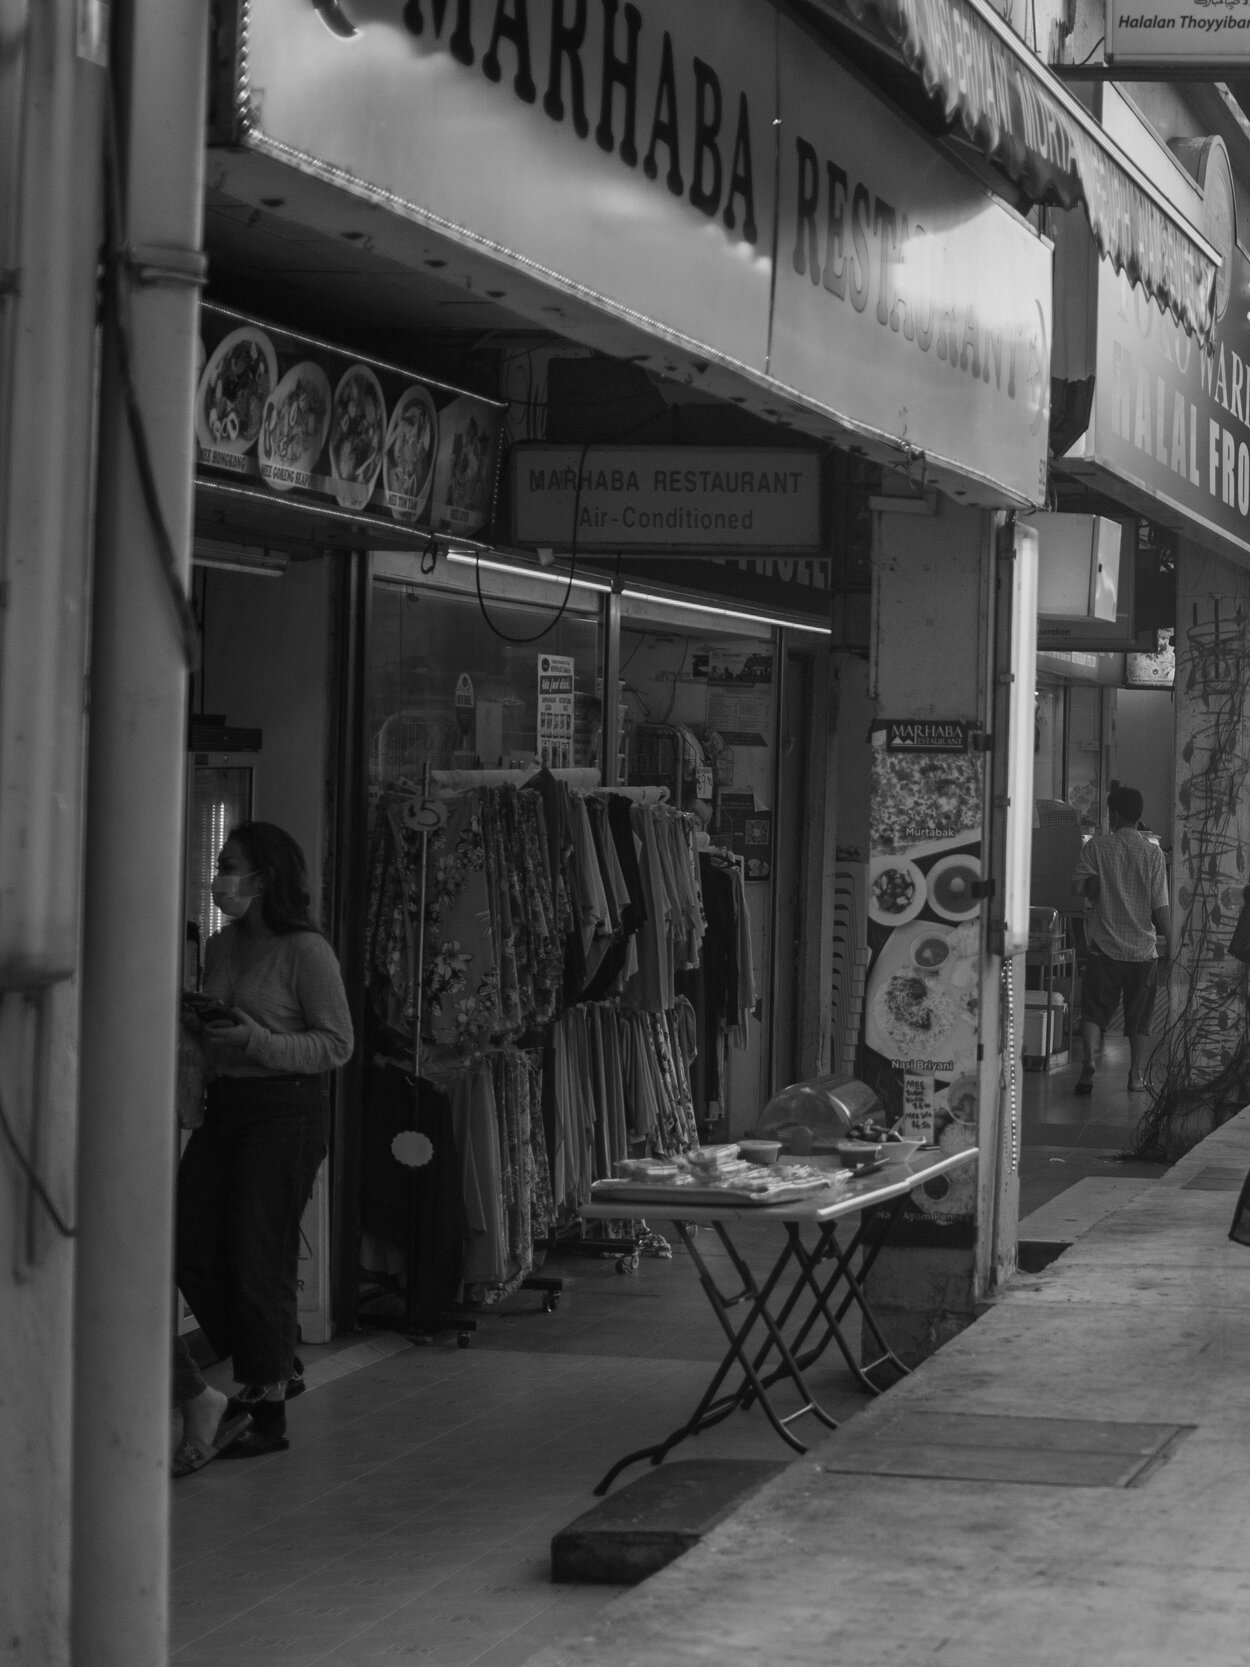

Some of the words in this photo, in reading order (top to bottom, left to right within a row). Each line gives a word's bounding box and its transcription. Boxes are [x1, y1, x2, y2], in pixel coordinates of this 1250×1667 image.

[1118, 15, 1175, 28] Halalan
[529, 469, 641, 493] MARHABA
[653, 469, 802, 493] RESTAURANT
[578, 505, 753, 530] Air-Conditioned
[891, 724, 963, 745] MARHABA
[905, 828, 955, 837] Murtabak
[891, 1060, 914, 1070] Nasi
[916, 1060, 953, 1072] Briyani
